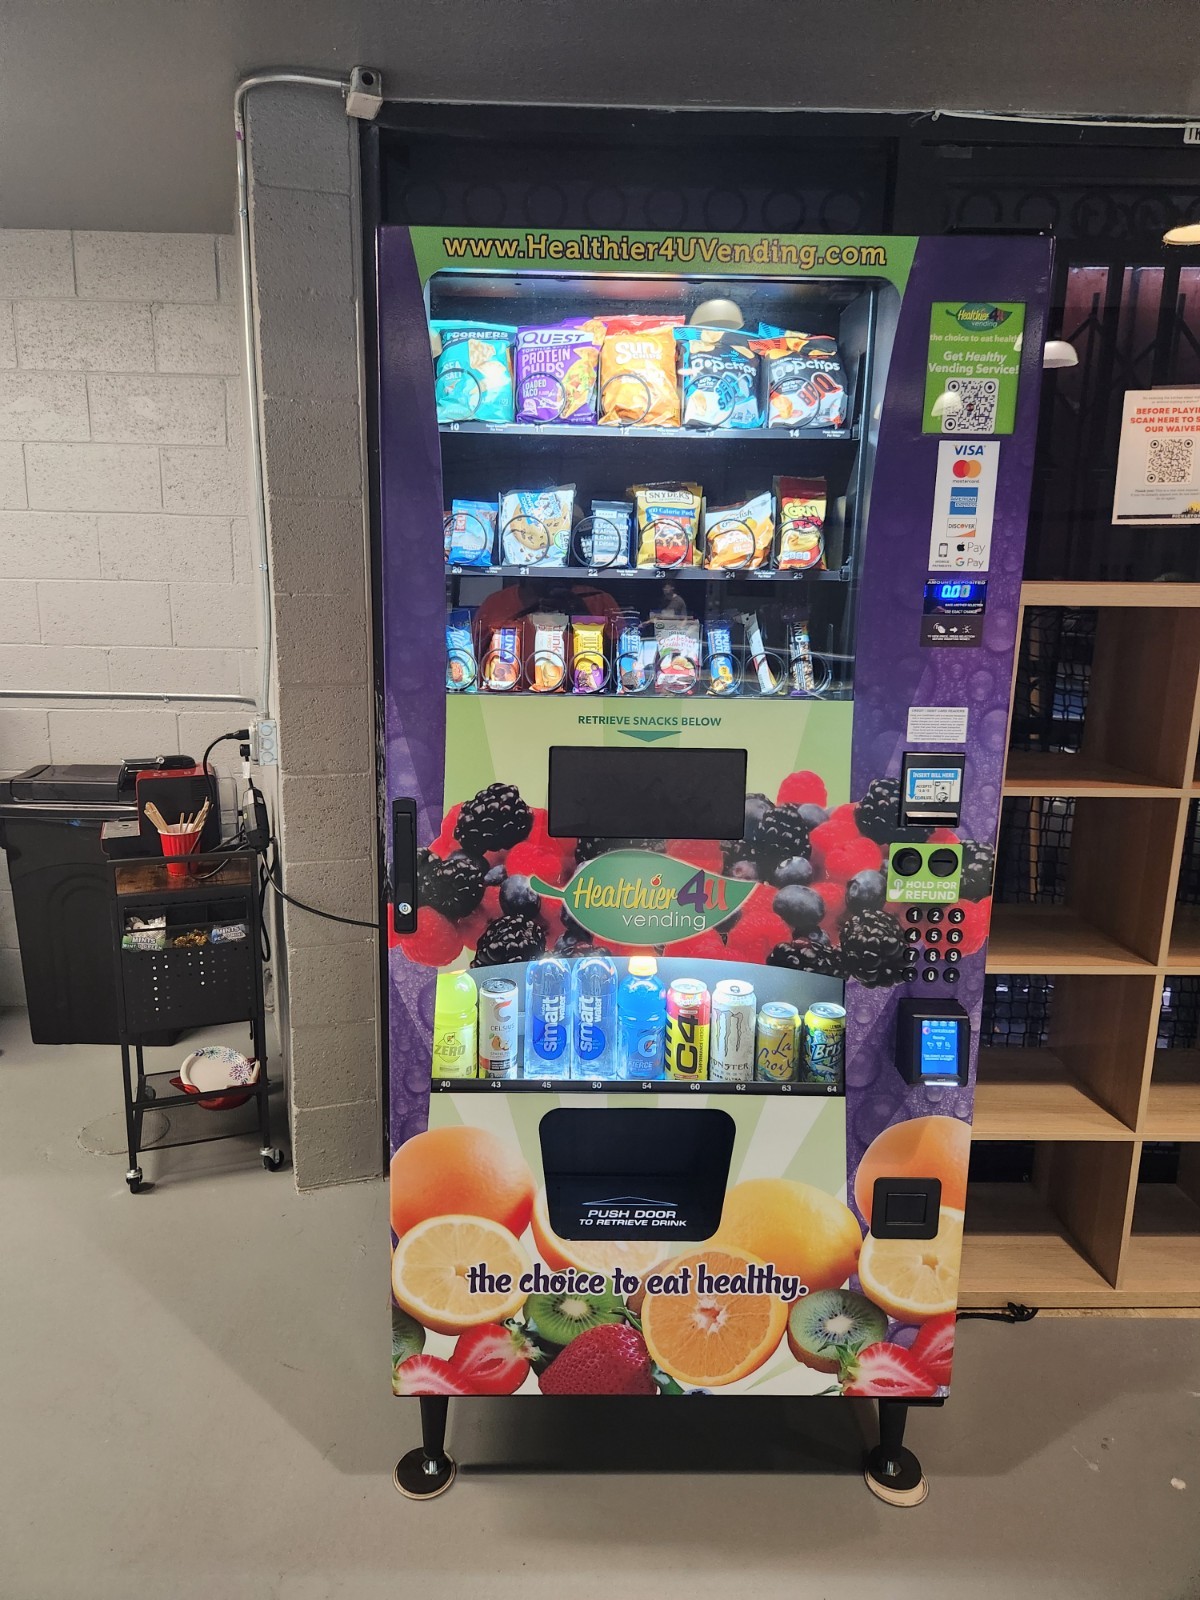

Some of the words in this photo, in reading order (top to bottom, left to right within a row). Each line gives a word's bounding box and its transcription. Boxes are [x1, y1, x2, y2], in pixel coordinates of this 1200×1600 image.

[442, 233, 887, 270] www.Healthier4UVending.com
[971, 320, 998, 328] vending
[522, 332, 585, 345] QUEST
[929, 333, 942, 341] the
[944, 333, 969, 342] choice
[971, 334, 979, 342] to
[522, 348, 571, 367] PROTEIN
[943, 351, 963, 361] Get
[965, 352, 1007, 365] Healthy
[928, 362, 974, 376] Vending
[975, 364, 1019, 375] Service!
[797, 372, 842, 406] BBQ
[1136, 407, 1170, 415] BEFORE
[450, 423, 460, 431] 10
[620, 427, 629, 435] 12
[789, 429, 800, 438] 14
[954, 445, 984, 456] VISA
[660, 507, 680, 515] Calorie
[784, 502, 819, 518] CORN
[967, 541, 986, 555] Pay
[967, 557, 984, 569] Pay
[452, 566, 462, 574] 20
[520, 567, 530, 575] 21
[656, 570, 666, 578] 23
[726, 571, 736, 579] 24
[794, 622, 803, 642] KIND
[504, 629, 514, 660] LUNA
[714, 629, 726, 668] PROTN
[578, 715, 630, 725] RETRIEVE
[633, 716, 678, 726] SNACKS
[682, 717, 722, 726] BELOW
[906, 881, 934, 889] HOLD
[906, 890, 956, 900] REFUND
[622, 911, 706, 930] vending
[912, 911, 918, 920] 1
[932, 911, 939, 921] 2
[954, 912, 961, 922] 3
[909, 931, 916, 940] 4
[931, 931, 938, 941] 5
[951, 932, 959, 941] 6
[909, 951, 916, 960] 7
[929, 951, 936, 961] 8
[950, 951, 958, 961] 9
[928, 971, 934, 980] 0
[594, 996, 602, 1022] water
[490, 1023, 515, 1032] CELSIUS
[543, 996, 559, 1052] smart
[579, 995, 594, 1052] smart
[638, 1034, 657, 1058] G
[676, 1014, 698, 1074] C4
[771, 1032, 793, 1058] La
[434, 1044, 466, 1056] ZERO
[758, 1047, 796, 1076] Croix
[440, 1080, 450, 1088] 40
[541, 1081, 551, 1089] 45
[592, 1081, 602, 1089] 50
[781, 1084, 792, 1092] 63
[588, 1209, 630, 1219] PUSH
[634, 1210, 676, 1219] DOOR
[579, 1218, 593, 1226] TO
[596, 1218, 649, 1227] RETRIEVE
[652, 1219, 687, 1227] DRINK
[467, 1262, 511, 1294] the
[519, 1262, 605, 1294] choice
[612, 1266, 640, 1295] to
[646, 1267, 692, 1295] eat
[696, 1263, 809, 1301] healthy.
